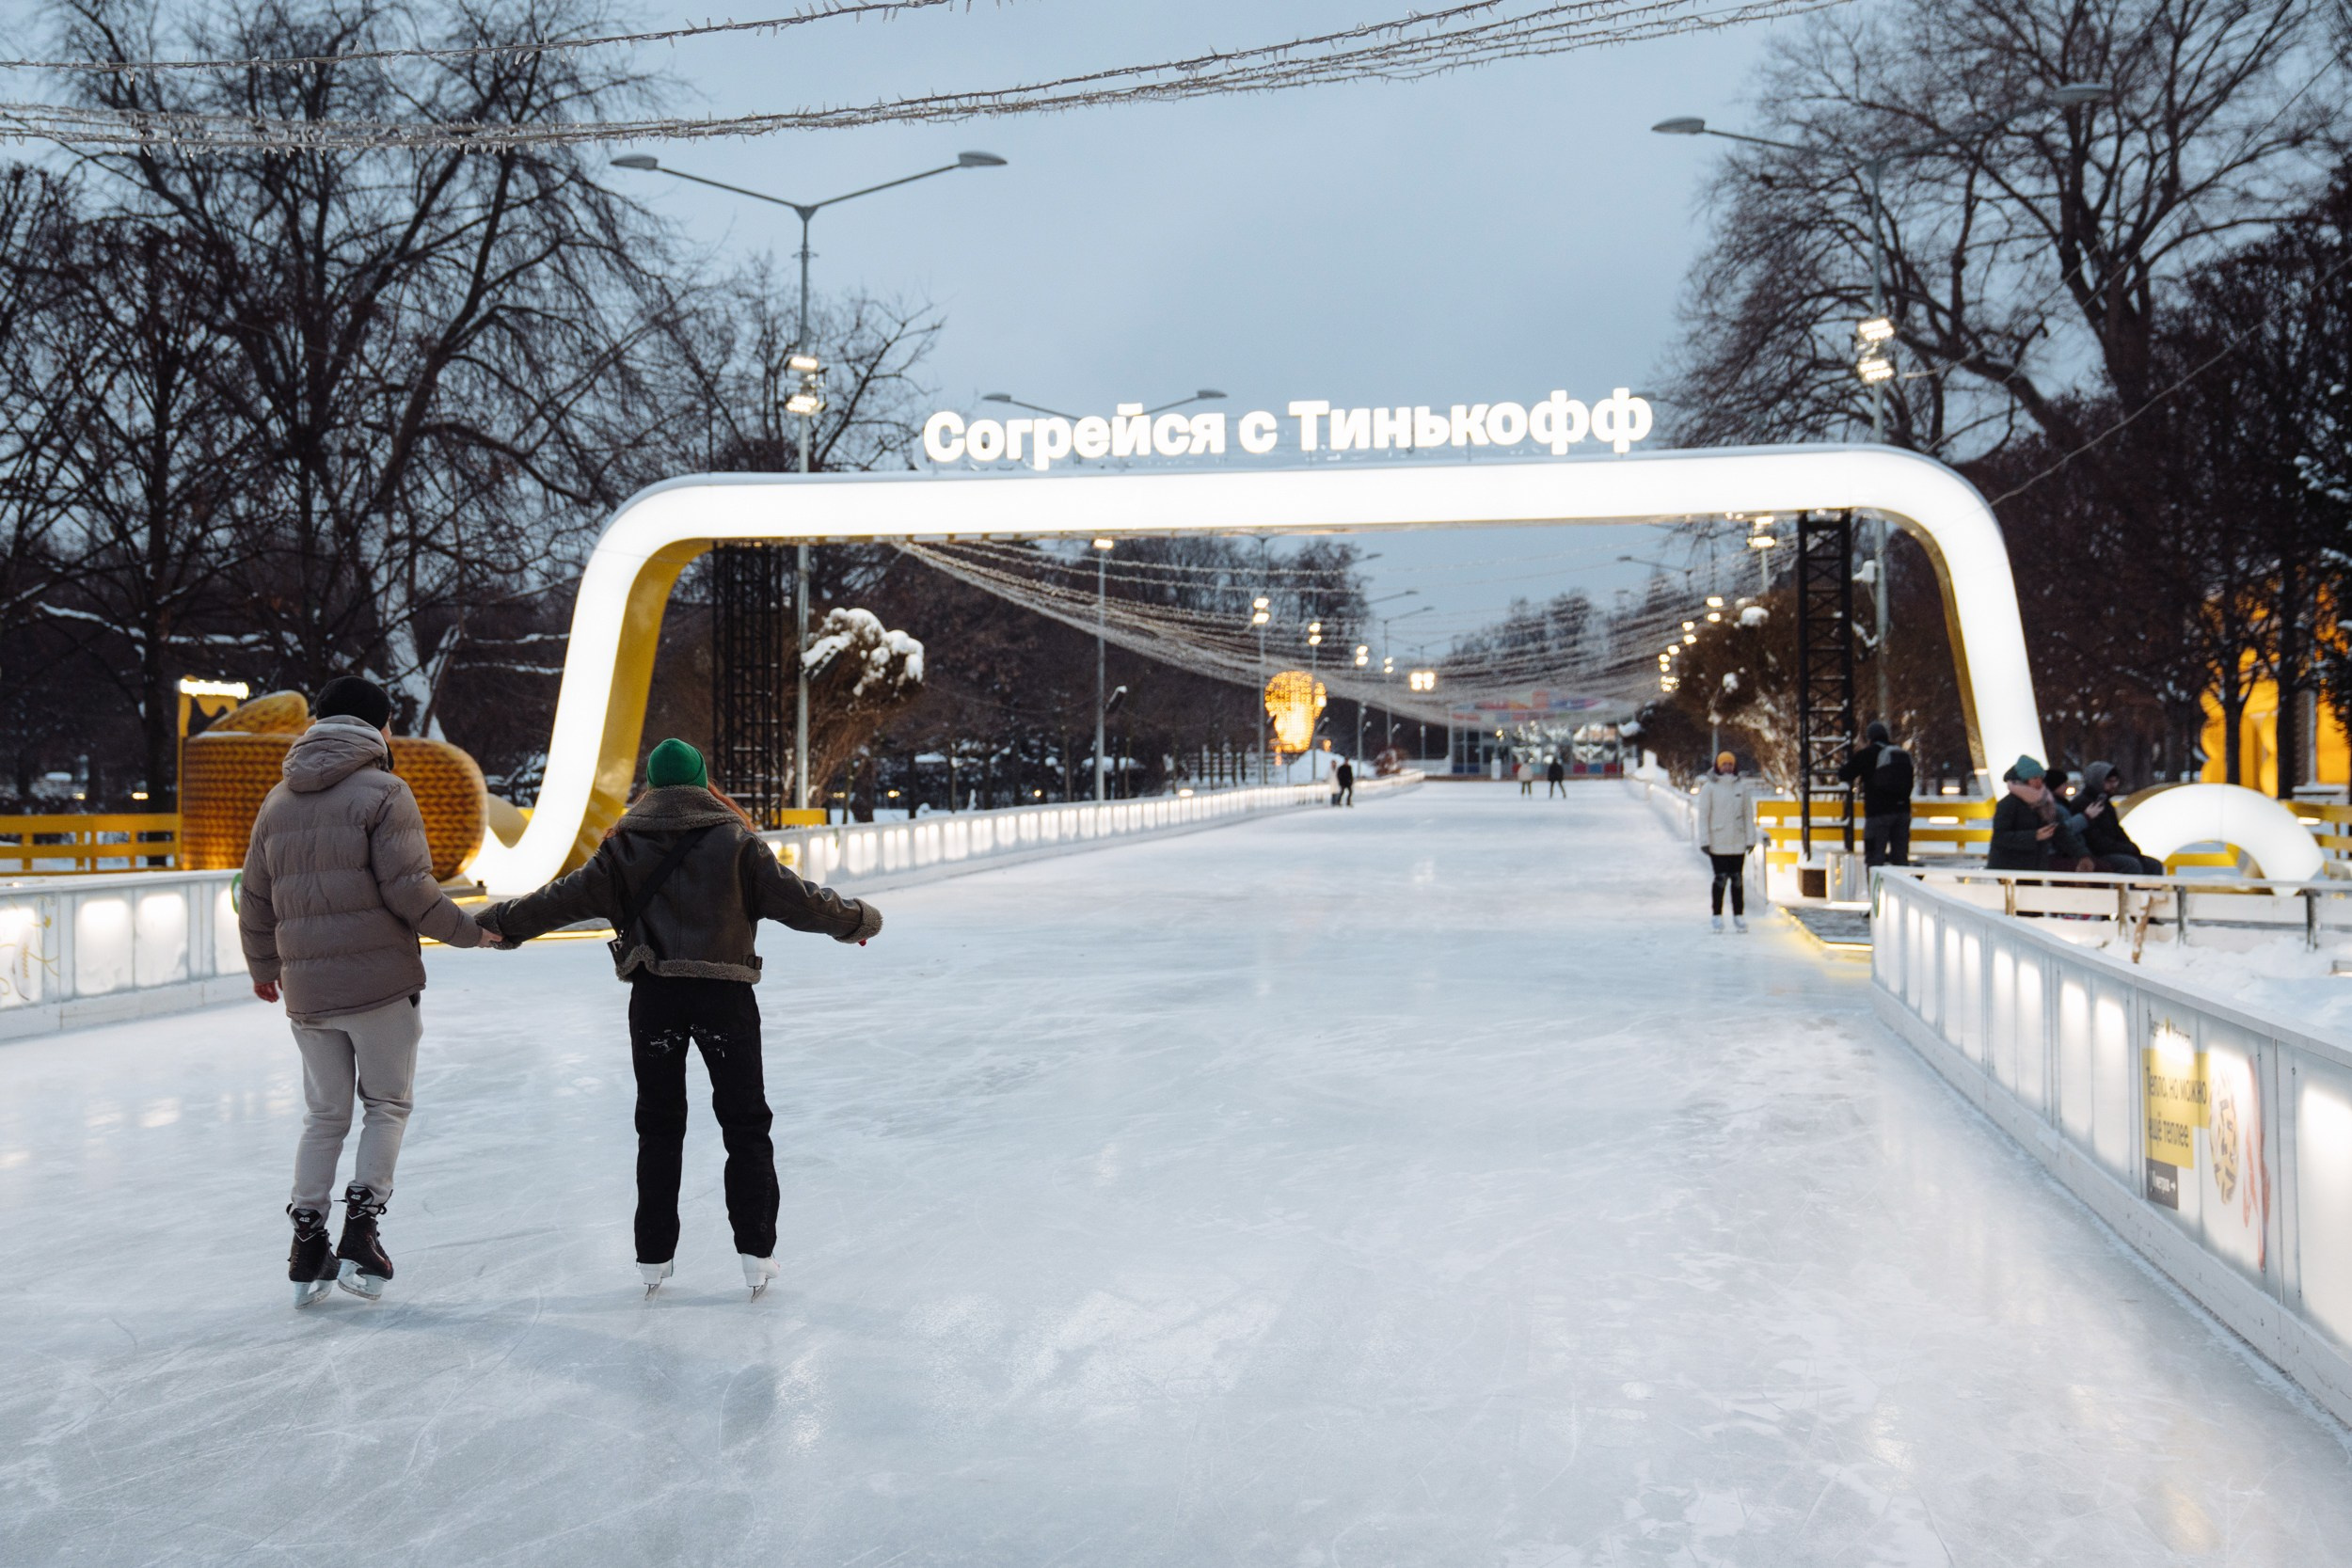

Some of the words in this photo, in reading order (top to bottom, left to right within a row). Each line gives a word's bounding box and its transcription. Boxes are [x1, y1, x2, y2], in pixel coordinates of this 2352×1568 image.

[923, 403, 1226, 471] Согрейся
[1239, 410, 1278, 453] с
[1288, 388, 1653, 455] Тинькофф
[2163, 1119, 2189, 1148] теплее
